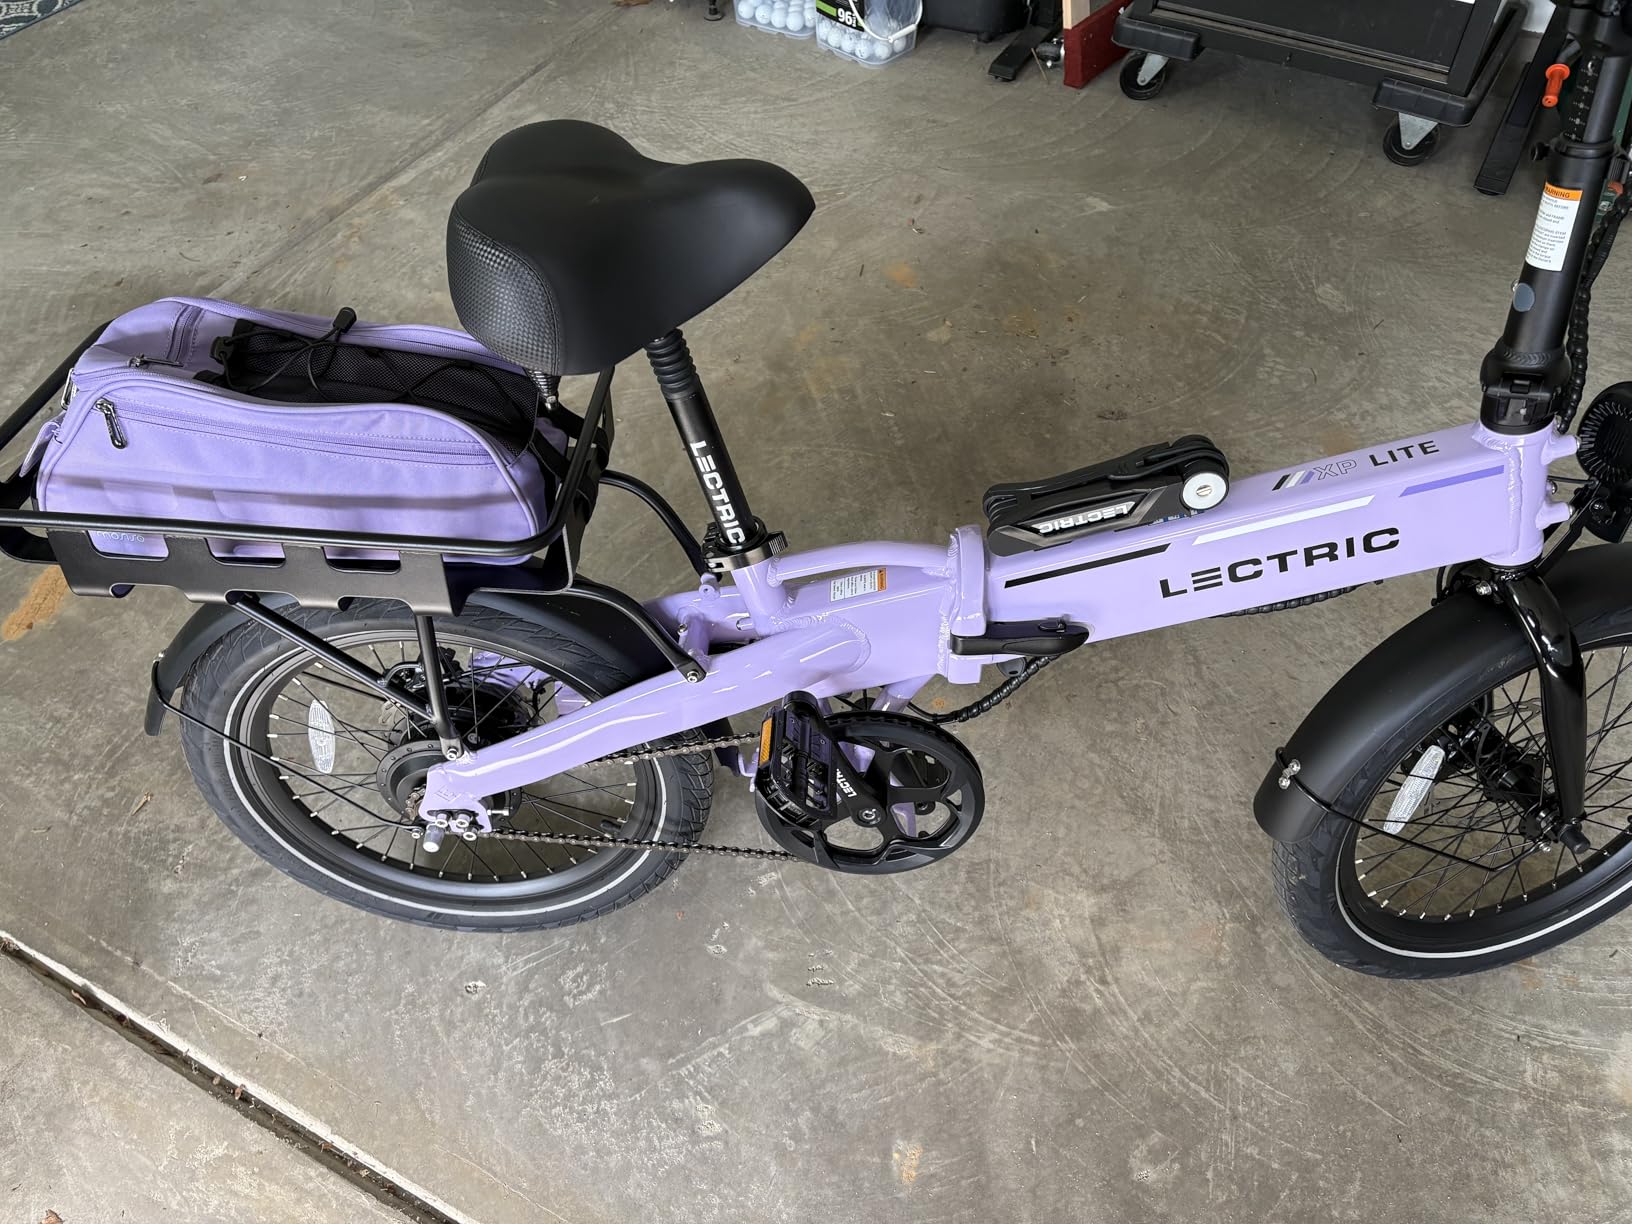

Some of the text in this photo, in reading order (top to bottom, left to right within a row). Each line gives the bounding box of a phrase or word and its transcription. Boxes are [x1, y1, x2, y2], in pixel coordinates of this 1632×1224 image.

[838, 8, 853, 26] 96
[1312, 440, 1440, 481] XP LITE
[690, 440, 746, 545] LECTRIC
[1038, 505, 1128, 535] LECTRIC
[1159, 527, 1400, 599] LECTRIC
